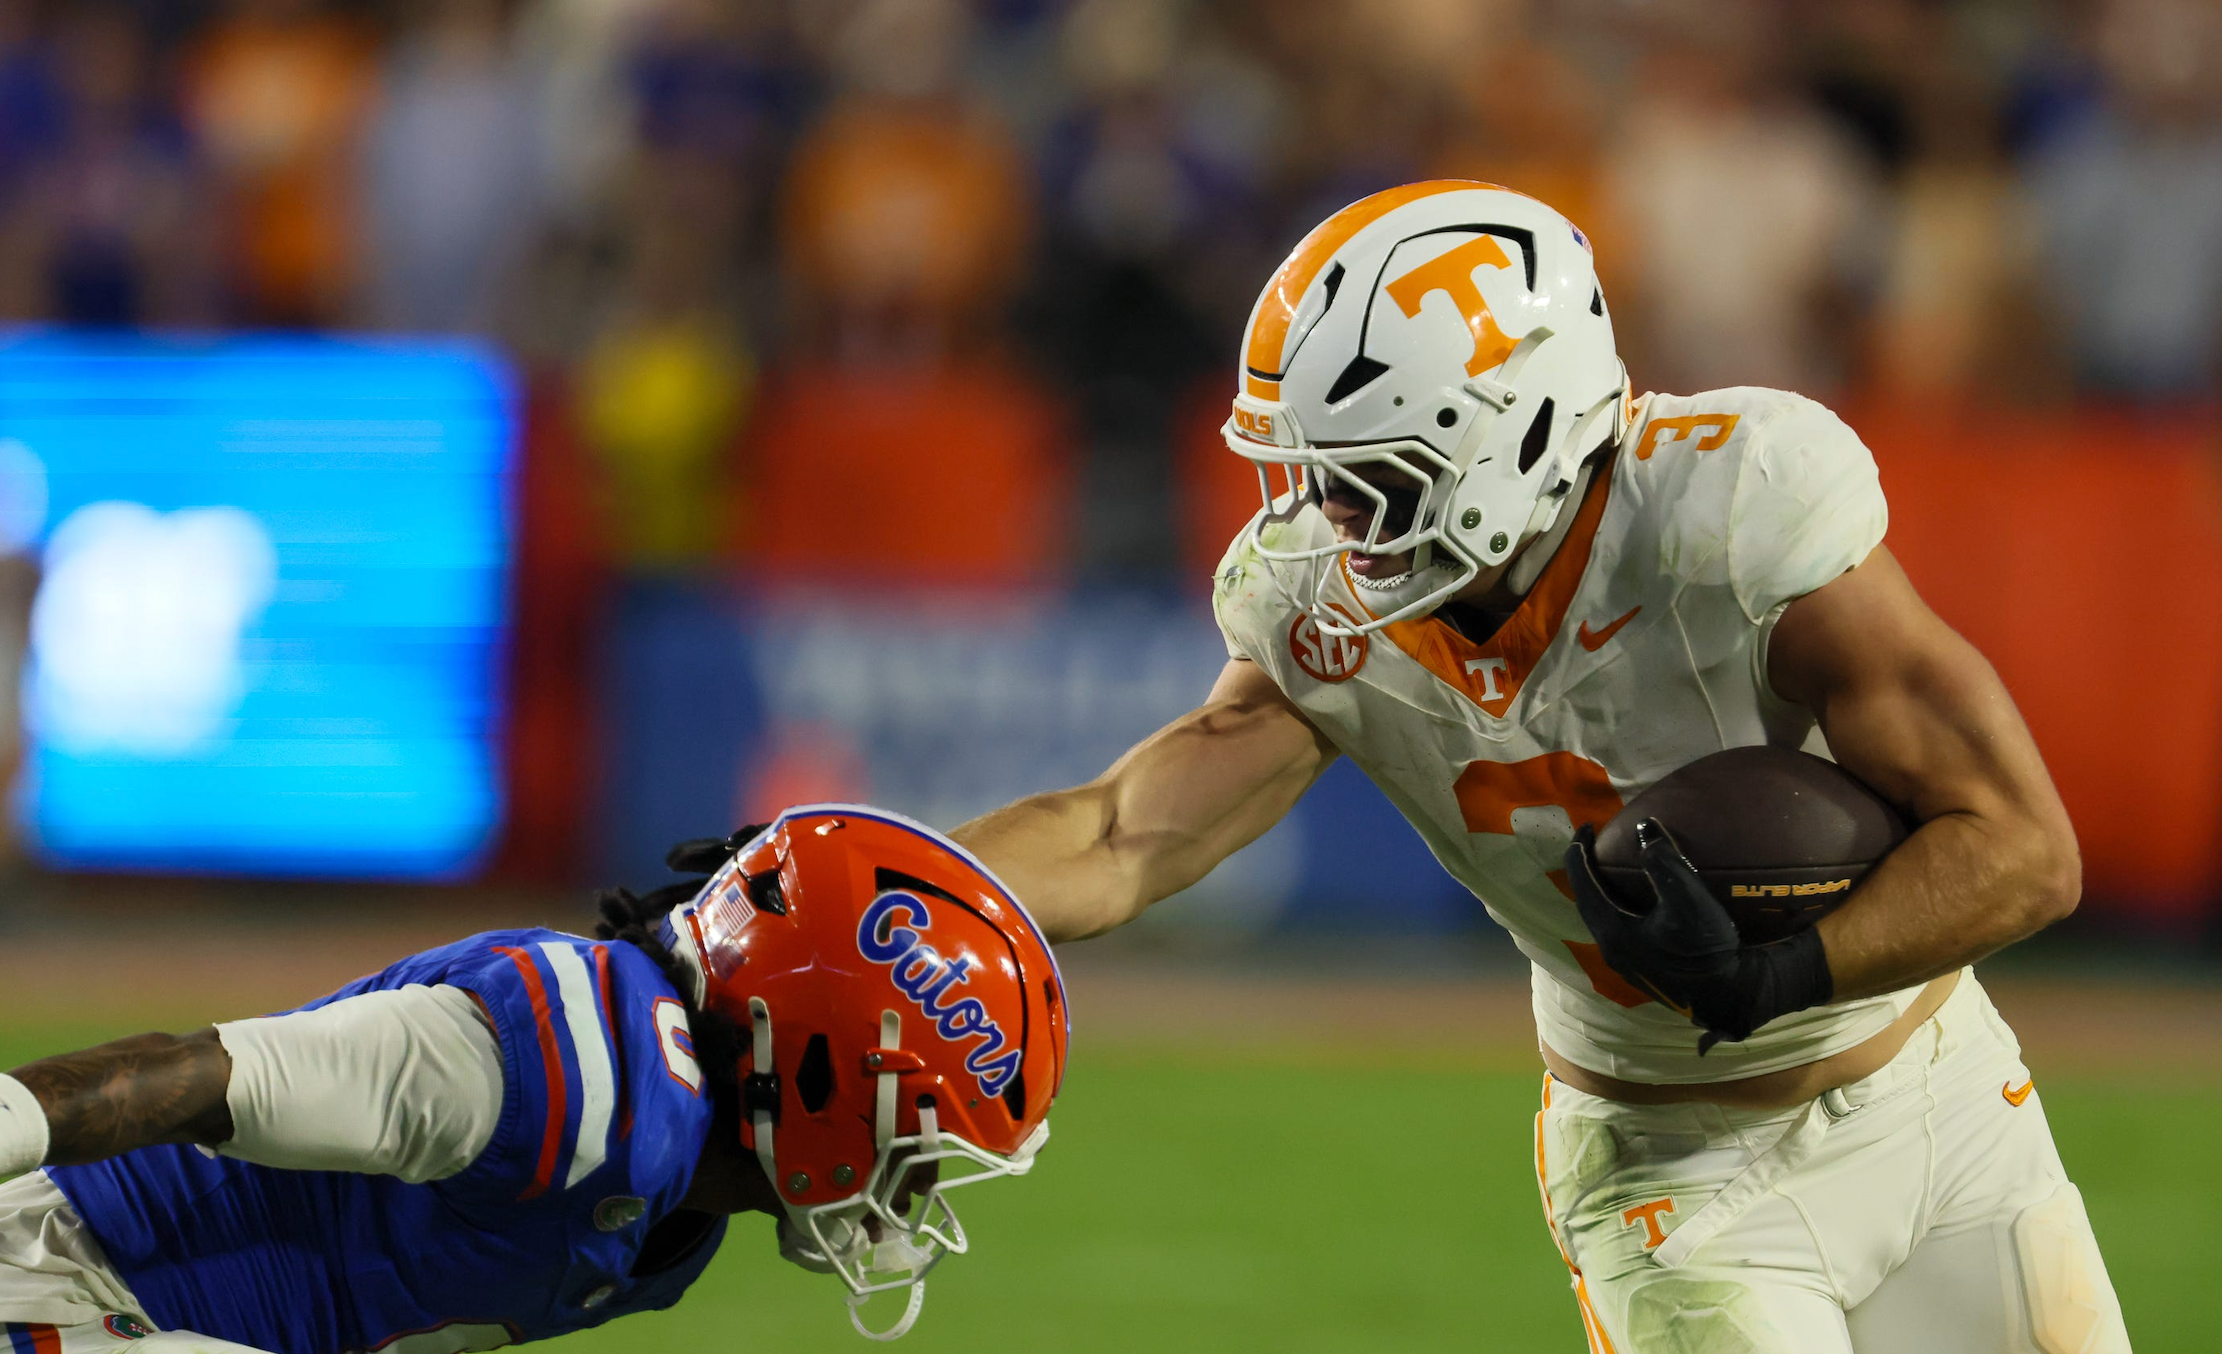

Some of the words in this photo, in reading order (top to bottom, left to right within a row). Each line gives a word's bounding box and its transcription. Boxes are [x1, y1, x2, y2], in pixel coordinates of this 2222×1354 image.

[1385, 233, 1523, 378] T
[1234, 405, 1271, 436] VOLS
[1636, 413, 1741, 461] 3
[1464, 657, 1507, 702] T
[1731, 885, 1791, 897] ELITE
[1792, 879, 1851, 896] VAPOR
[857, 890, 1021, 1099] Gators
[1619, 1194, 1678, 1252] T
